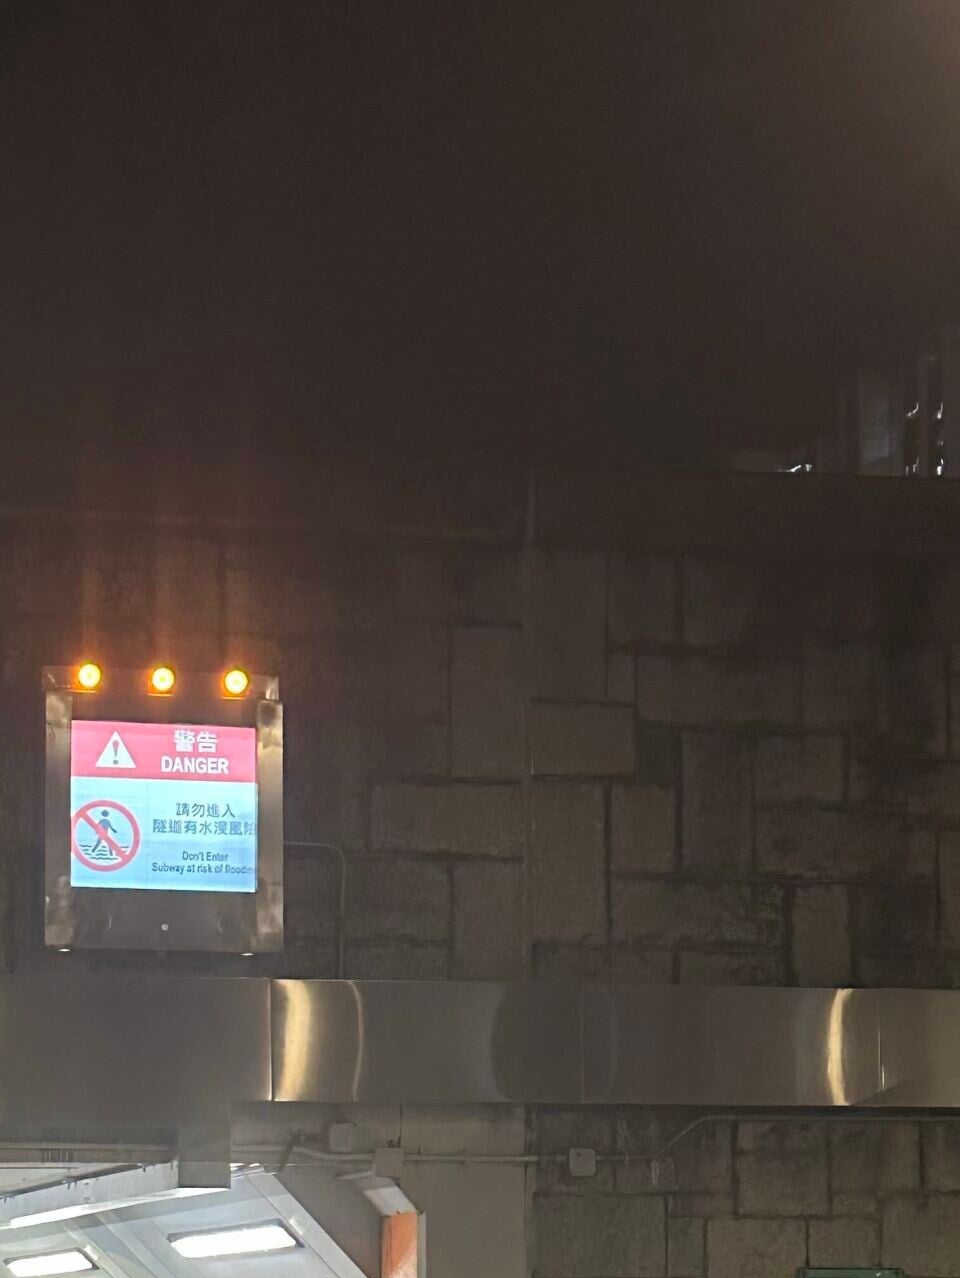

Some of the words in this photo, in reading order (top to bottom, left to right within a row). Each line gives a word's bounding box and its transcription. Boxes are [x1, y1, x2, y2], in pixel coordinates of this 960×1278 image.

[174, 729, 218, 753] 警告
[161, 755, 230, 775] DANGER
[175, 802, 236, 818] 請勿進入
[182, 851, 205, 862] Don't
[206, 851, 229, 862] Enter
[152, 862, 185, 875] Subway
[187, 864, 195, 874] at
[197, 864, 213, 874] risk
[214, 864, 224, 874] of
